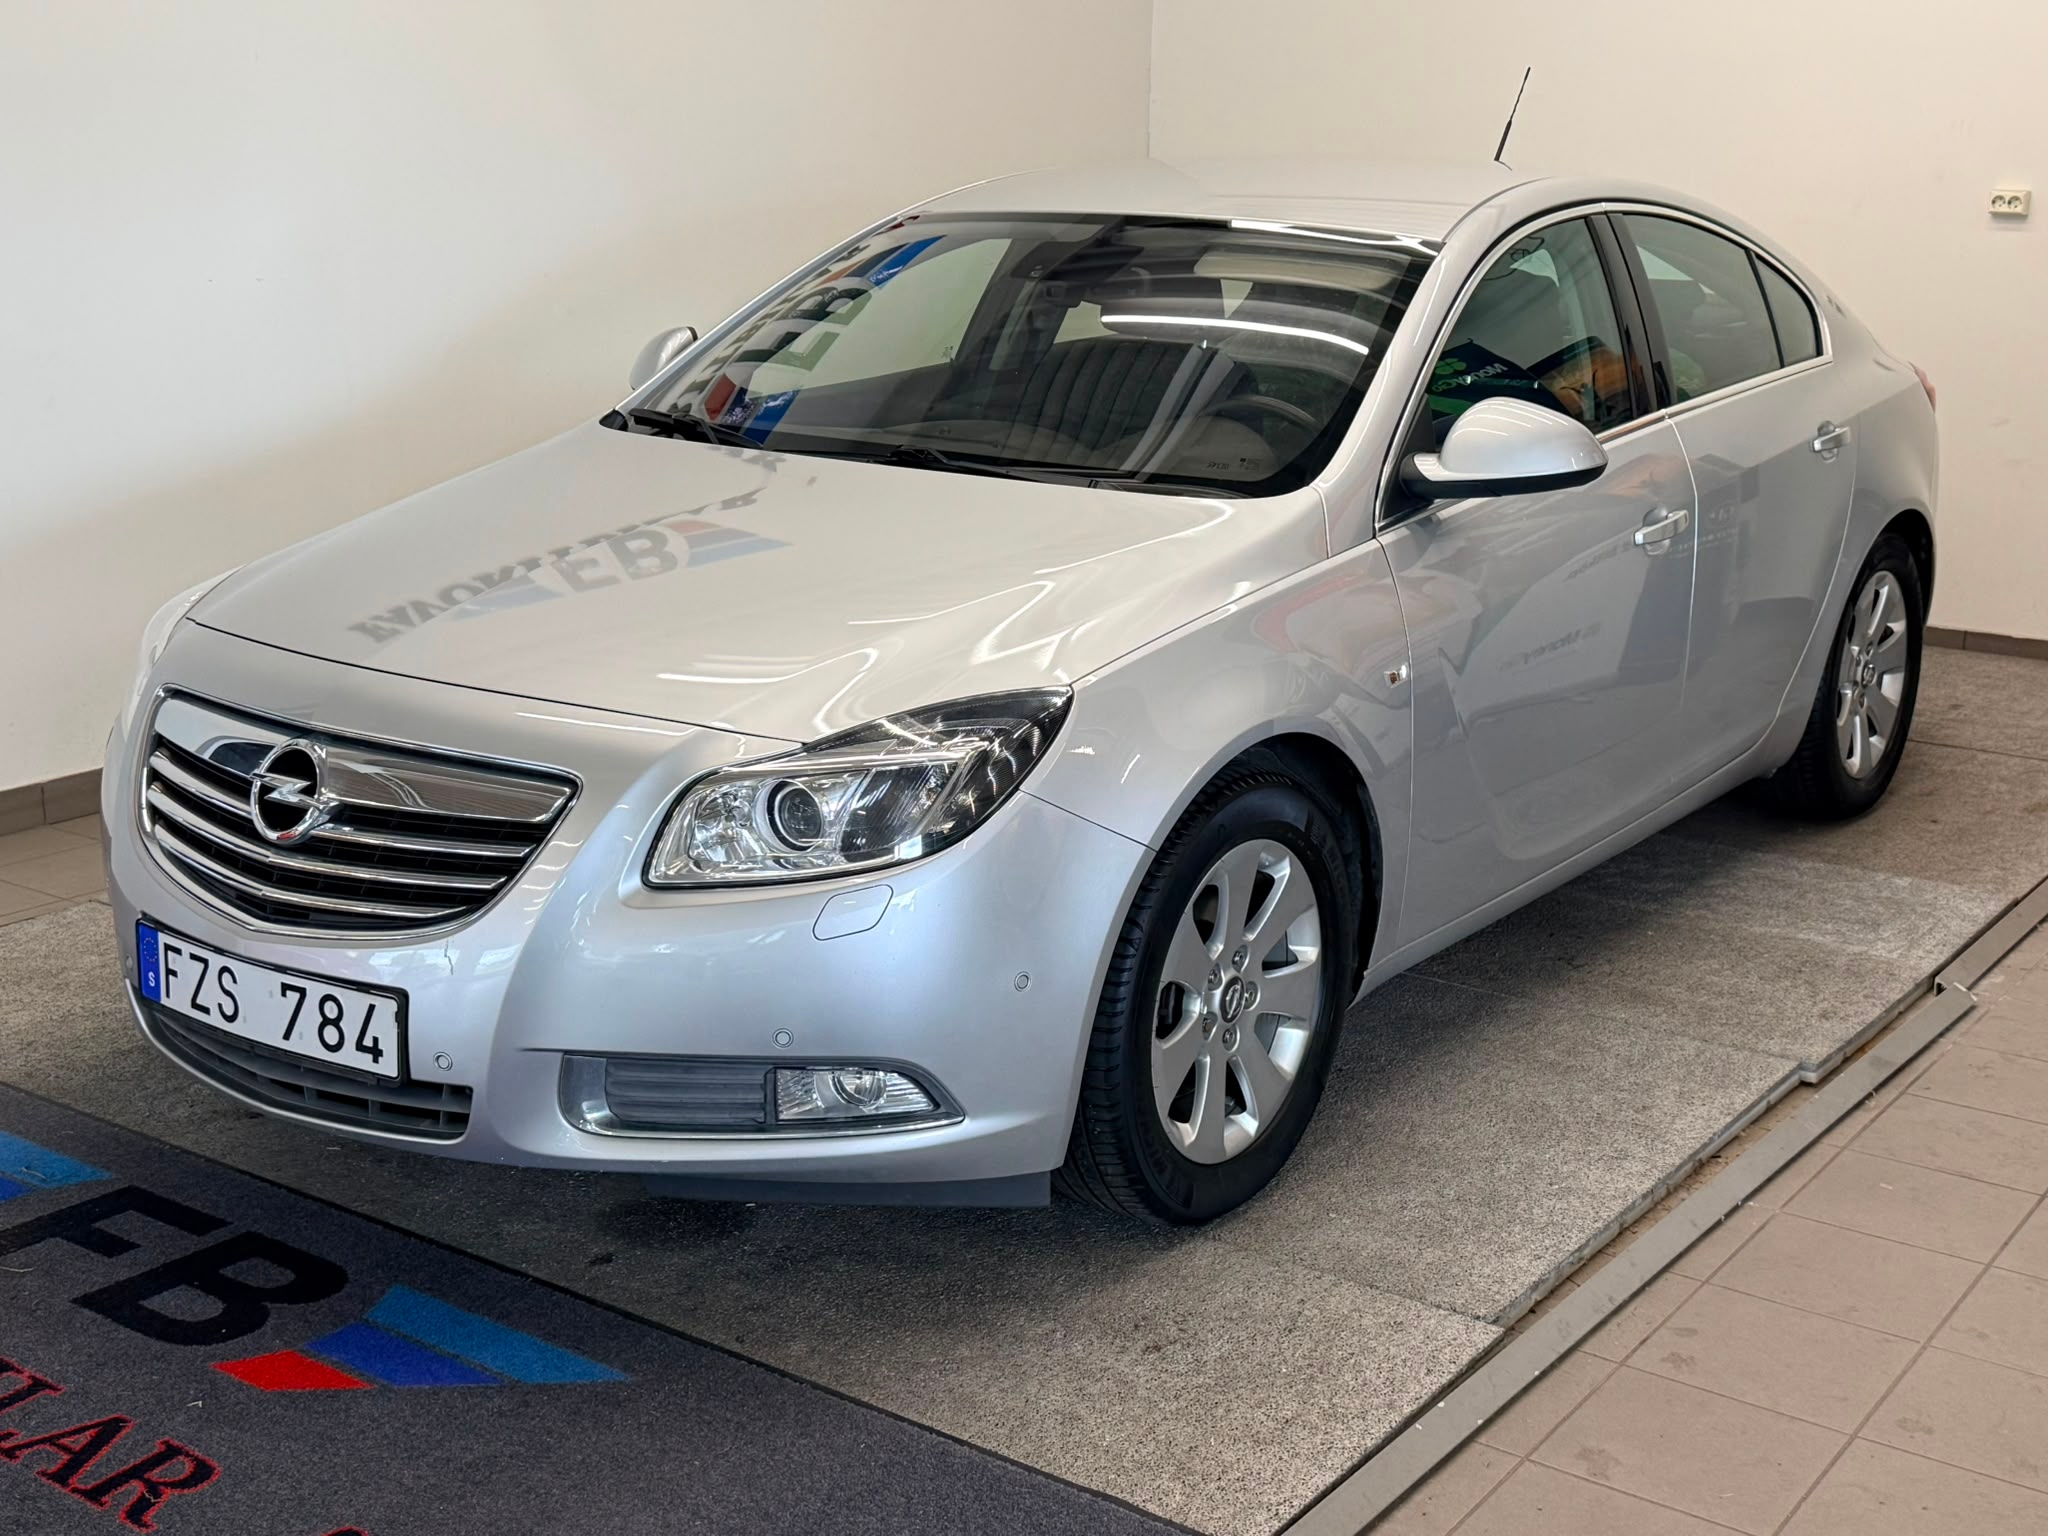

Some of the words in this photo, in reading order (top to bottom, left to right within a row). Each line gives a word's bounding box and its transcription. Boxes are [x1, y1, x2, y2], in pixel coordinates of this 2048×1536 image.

[147, 971, 156, 987] S
[162, 942, 240, 1024] FZS
[280, 981, 384, 1064] 784
